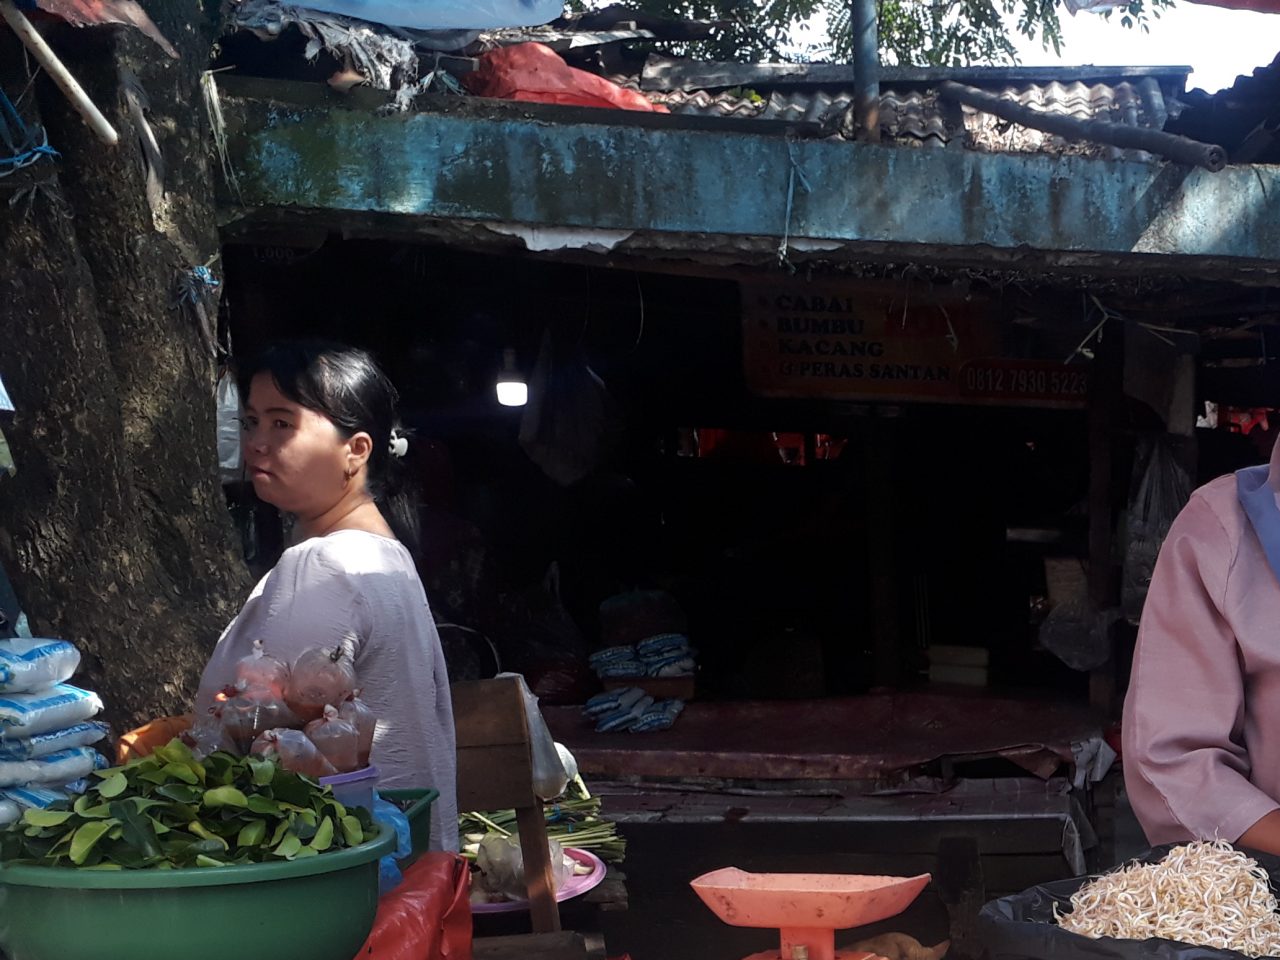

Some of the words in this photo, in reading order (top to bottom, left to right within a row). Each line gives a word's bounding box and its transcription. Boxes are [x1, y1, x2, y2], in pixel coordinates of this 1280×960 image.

[775, 295, 854, 313] CABAI
[776, 316, 865, 335] BUMBU
[777, 338, 885, 358] KACANG
[799, 361, 864, 378] PERAS
[869, 363, 950, 381] SANTAN
[966, 367, 1004, 391] 0812
[1009, 368, 1046, 393] 7930
